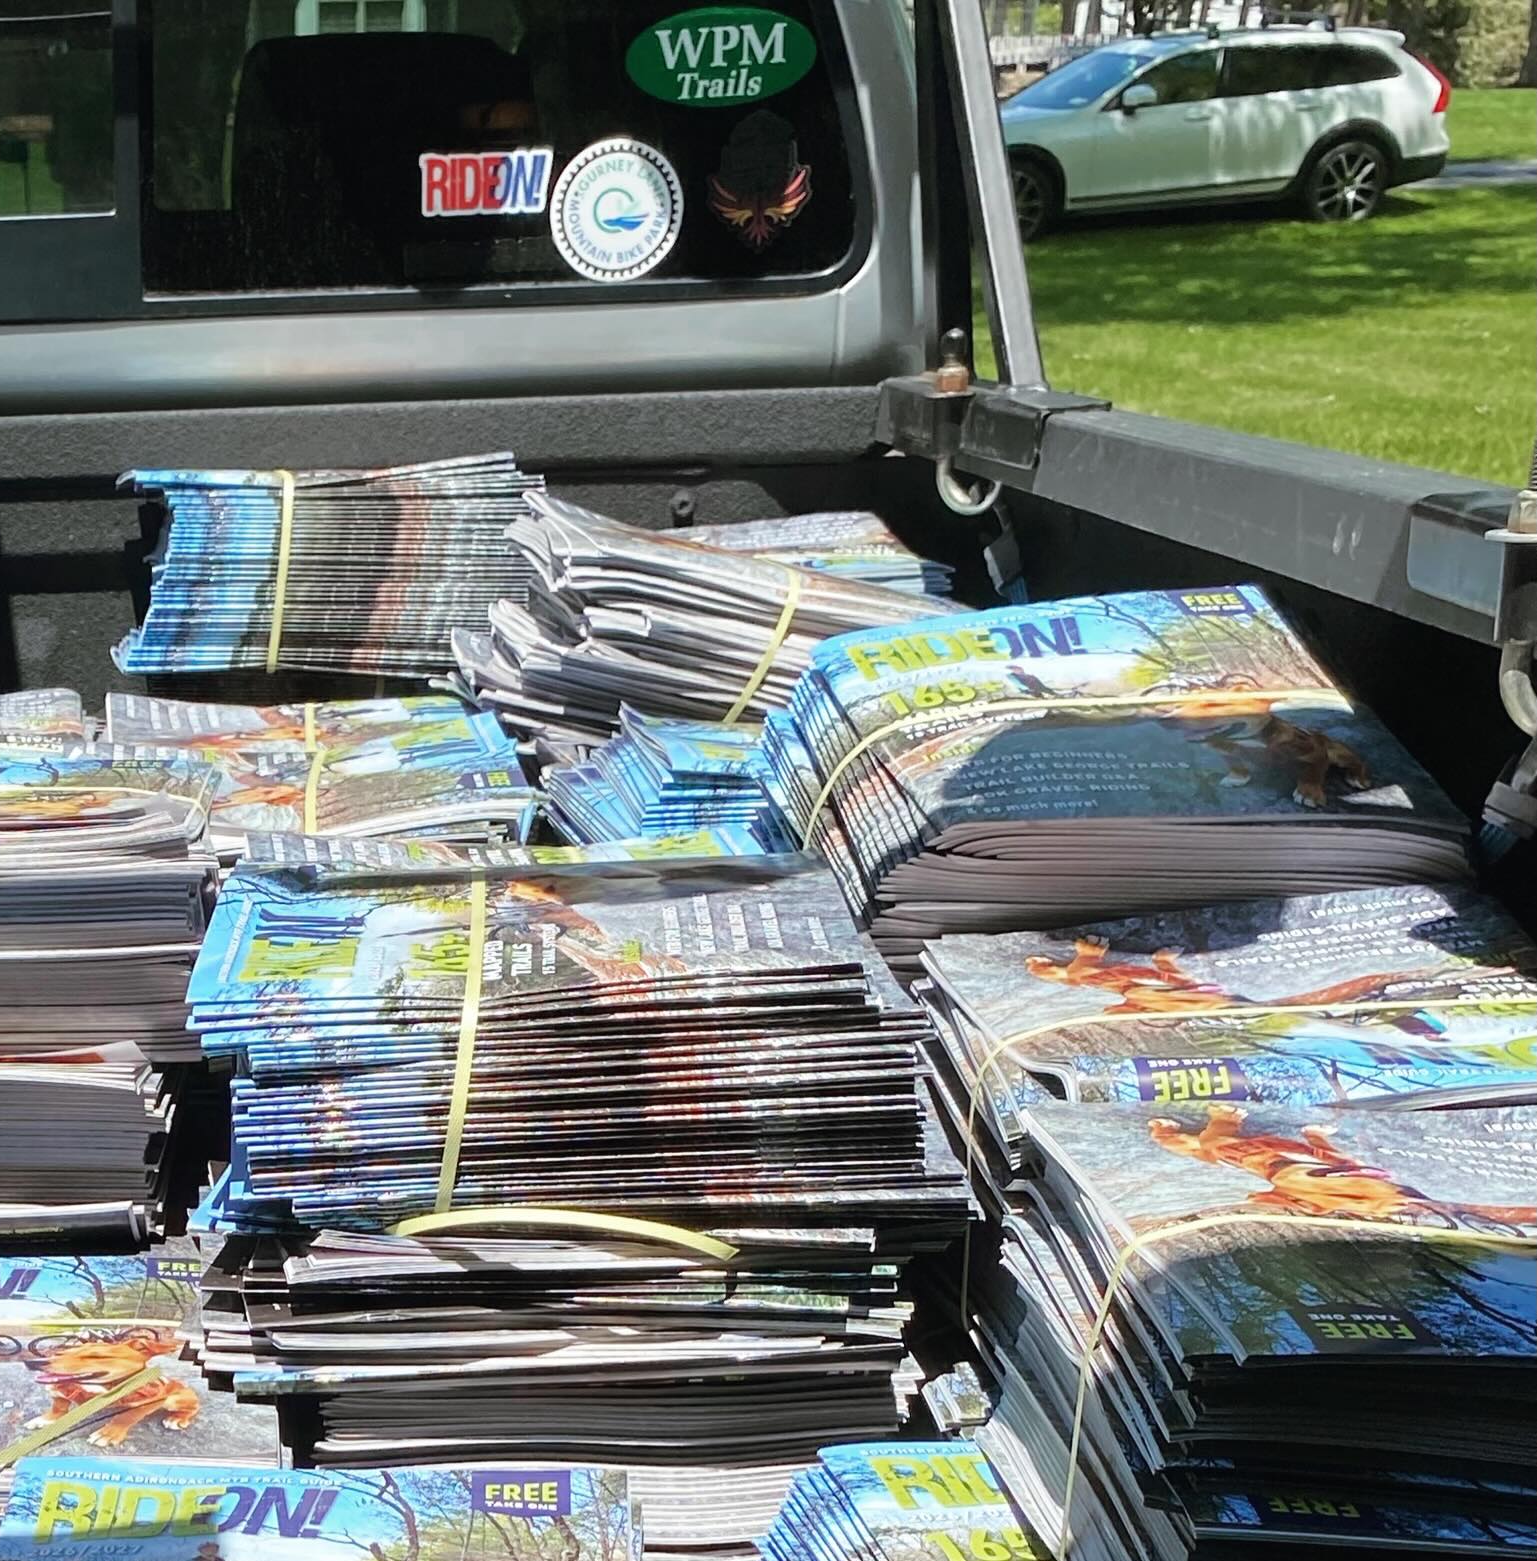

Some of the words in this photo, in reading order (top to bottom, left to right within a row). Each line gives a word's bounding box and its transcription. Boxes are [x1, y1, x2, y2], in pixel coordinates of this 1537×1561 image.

[654, 23, 788, 70] WPM
[677, 70, 762, 100] Trails
[426, 154, 545, 212] RIDEON!
[578, 160, 635, 191] GURNEY
[569, 202, 613, 263] MOUNTAIN
[617, 244, 644, 263] BIKE
[644, 211, 667, 246] PARK
[1180, 593, 1242, 607] FREE
[847, 616, 1088, 682] RIDEON!
[885, 678, 1006, 716] 165+
[482, 940, 503, 980] MAPPED
[511, 943, 533, 976] TRAILS
[1152, 1066, 1231, 1101] FREE
[1307, 1313, 1344, 1321] ONE
[1315, 1322, 1416, 1340] FREE
[1350, 1313, 1400, 1321] TAKE
[46, 1469, 121, 1483] SOUTHERN
[125, 1475, 215, 1486] ADIRONDACK
[220, 1476, 249, 1484] MTB
[254, 1476, 294, 1485] TRAIL
[485, 1481, 558, 1502] FREE
[33, 1480, 341, 1545] RIDEON!
[485, 1500, 524, 1508] TAKE
[527, 1502, 558, 1511] ONE
